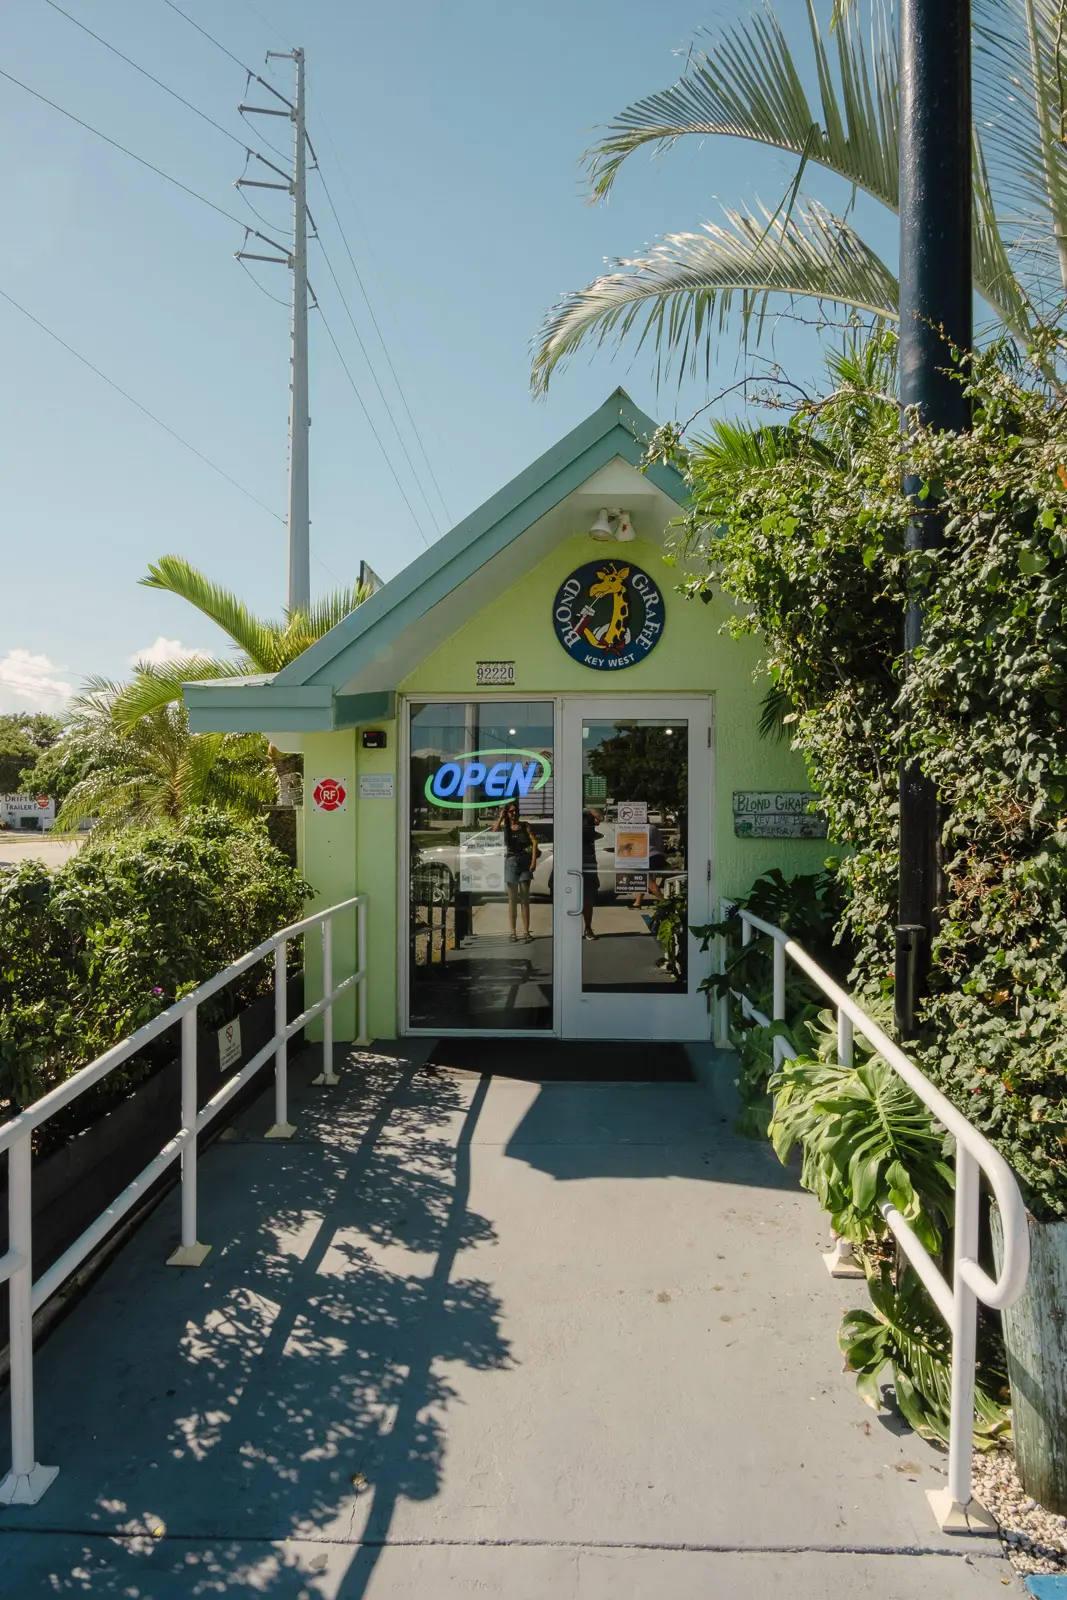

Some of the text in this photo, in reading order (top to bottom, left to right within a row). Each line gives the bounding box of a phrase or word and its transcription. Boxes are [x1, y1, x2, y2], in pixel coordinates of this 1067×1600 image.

[556, 573, 661, 650] BLOND GIRAFFE
[584, 653, 635, 667] KEY WEST
[476, 667, 514, 680] 92220
[432, 761, 538, 797] OPEN
[323, 790, 336, 800] RF
[737, 794, 809, 813] BLOND GIRAF
